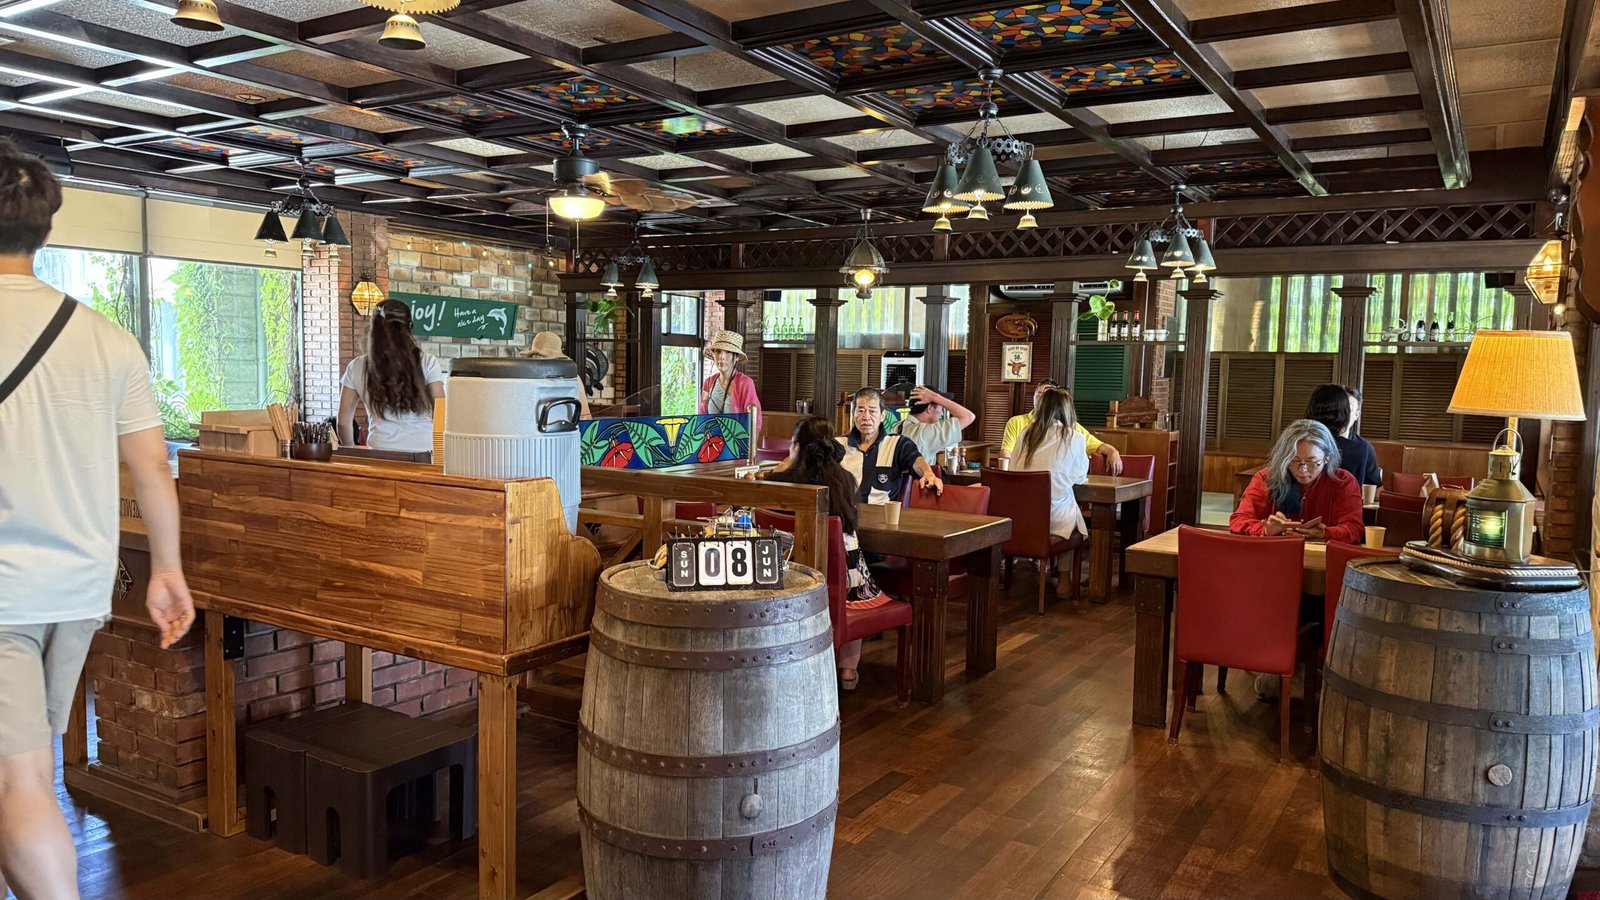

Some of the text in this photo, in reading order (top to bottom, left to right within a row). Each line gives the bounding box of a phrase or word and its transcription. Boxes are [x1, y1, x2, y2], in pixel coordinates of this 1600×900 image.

[410, 300, 446, 332] joy!
[454, 307, 471, 318] Have
[457, 314, 485, 328] nice day
[680, 545, 772, 578] SUN 08 JUN
